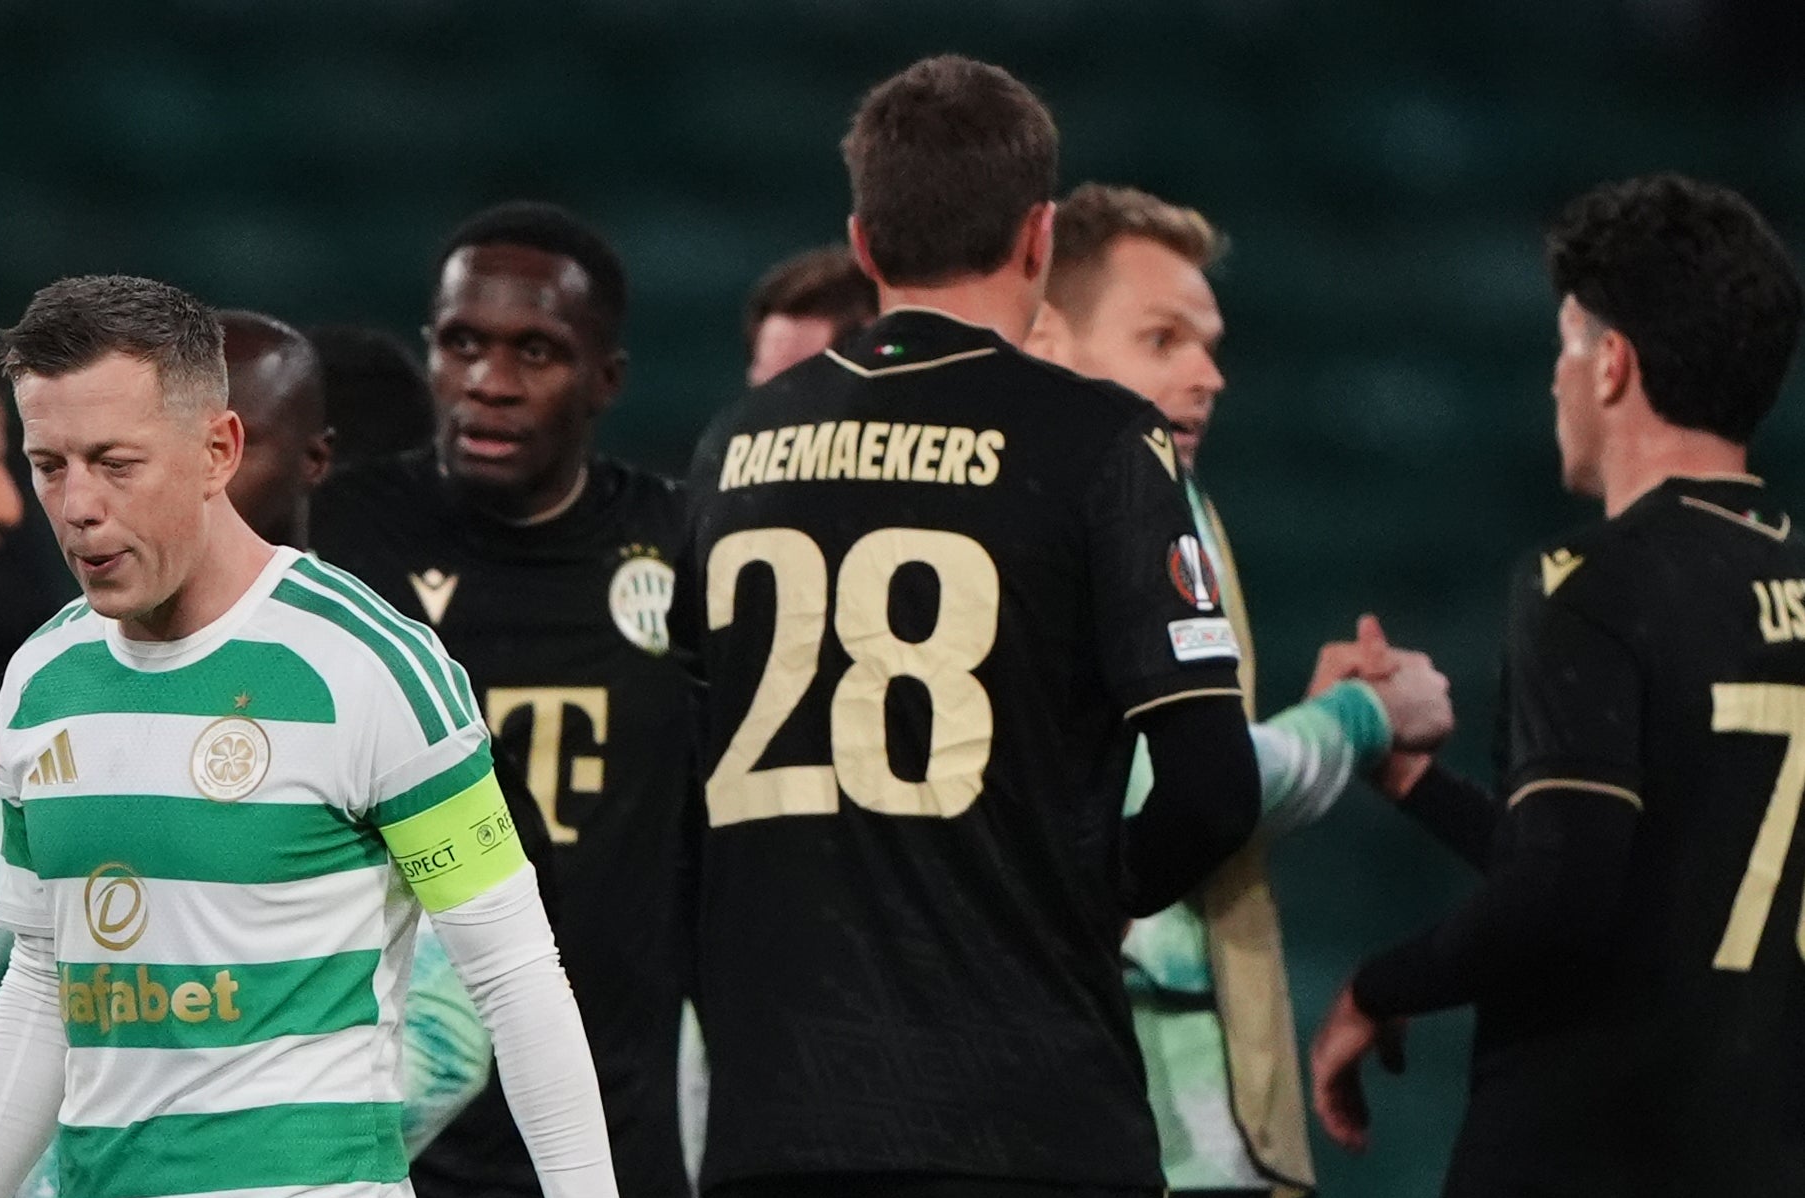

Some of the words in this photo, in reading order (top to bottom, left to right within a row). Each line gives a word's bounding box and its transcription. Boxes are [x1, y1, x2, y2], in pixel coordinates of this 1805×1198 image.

[719, 421, 1005, 491] RAEMAEKERS
[705, 527, 999, 828] 28
[1711, 682, 1805, 972] 7
